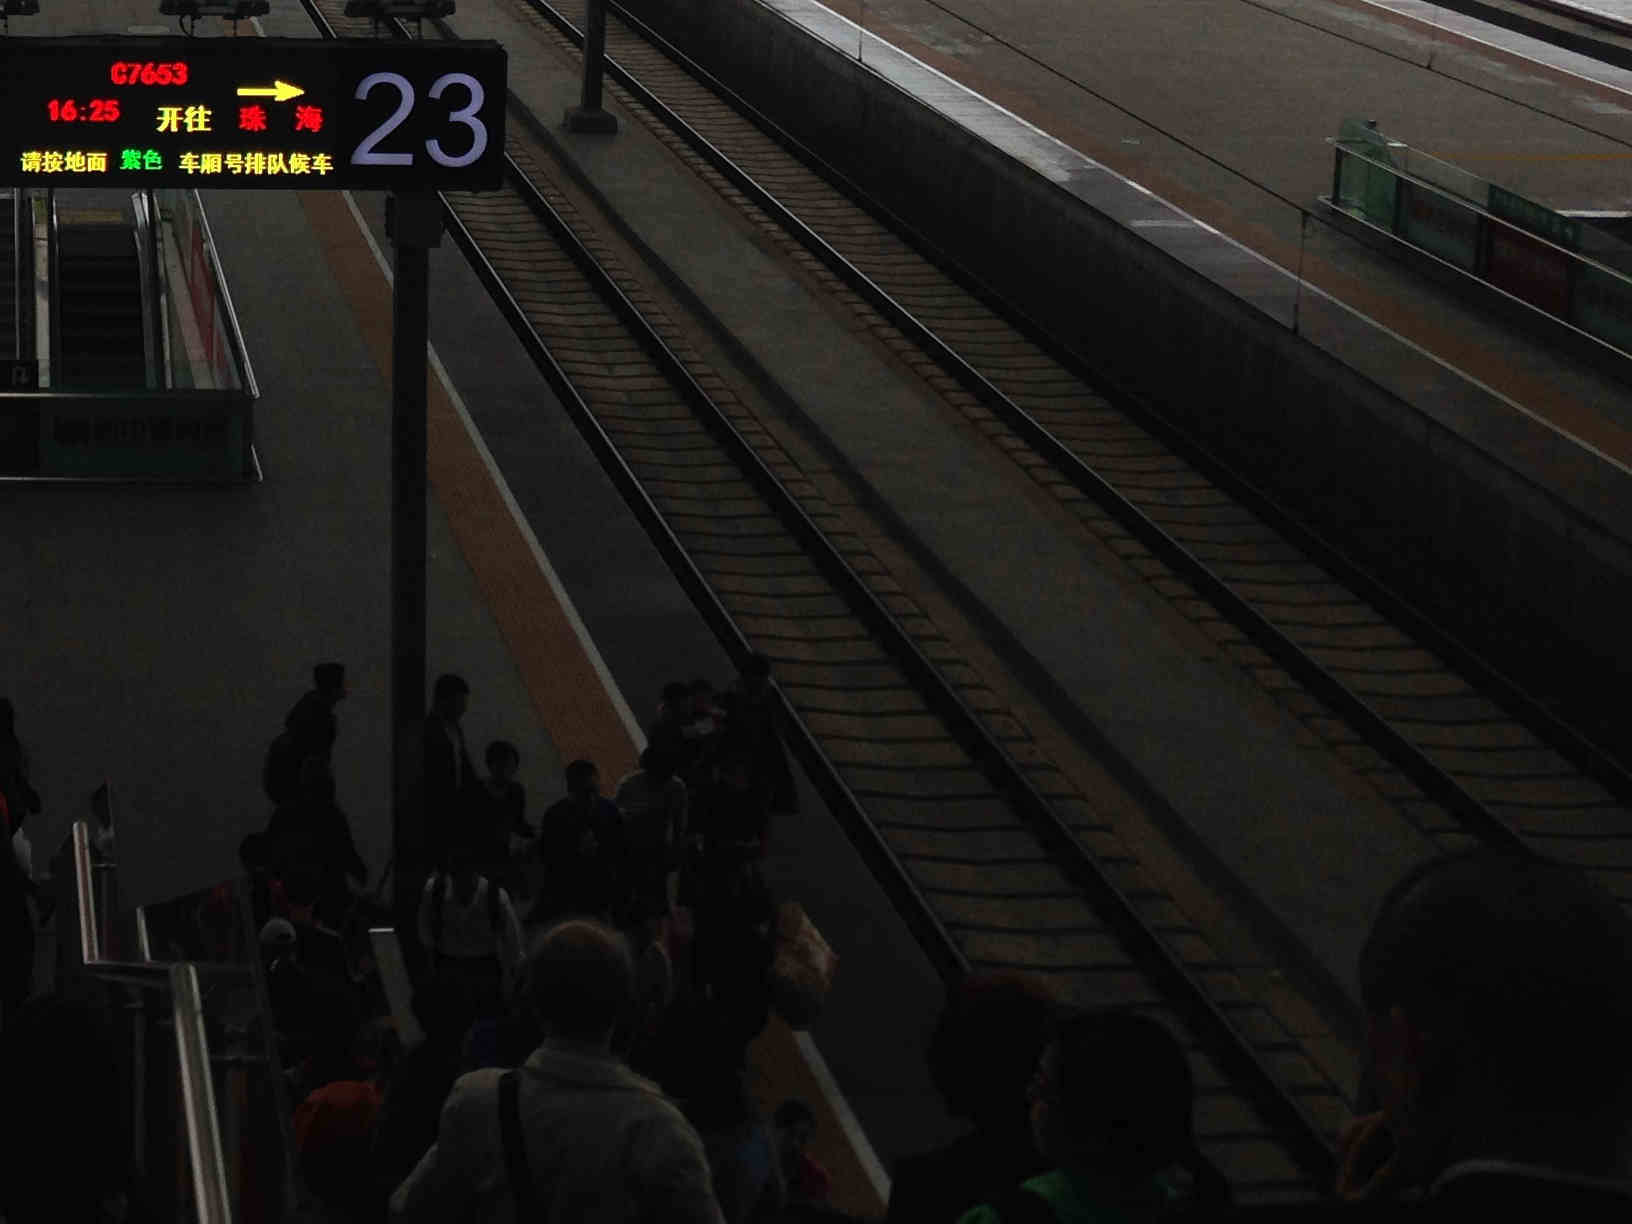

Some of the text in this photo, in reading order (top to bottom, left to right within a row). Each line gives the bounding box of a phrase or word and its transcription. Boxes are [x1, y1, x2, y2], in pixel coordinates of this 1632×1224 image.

[111, 62, 188, 85] C7653
[48, 99, 120, 122] 16:25
[157, 105, 212, 132] 开往
[352, 73, 486, 166] 23
[21, 149, 333, 175] 请按地面 紫色 车厢号排队候车
